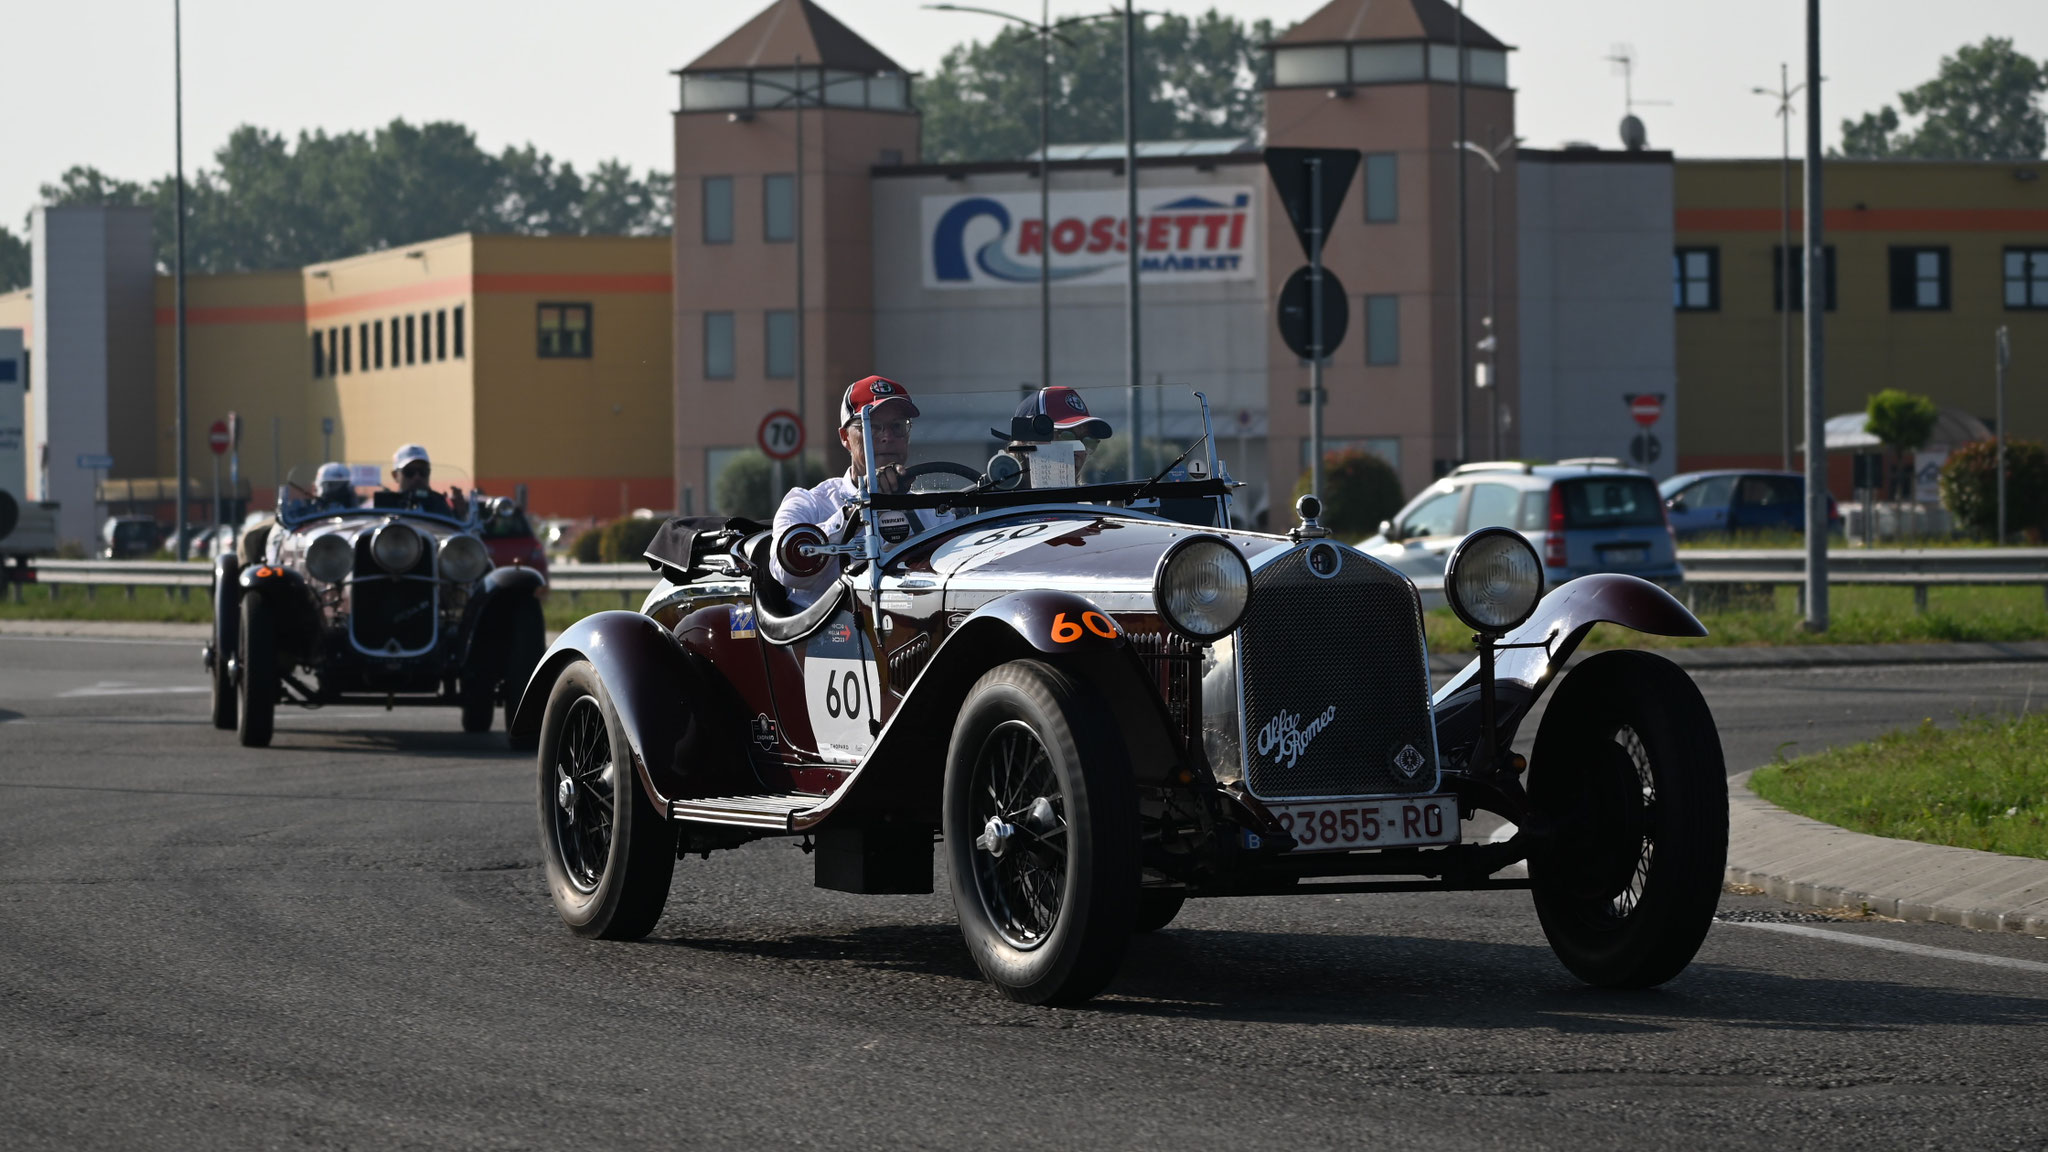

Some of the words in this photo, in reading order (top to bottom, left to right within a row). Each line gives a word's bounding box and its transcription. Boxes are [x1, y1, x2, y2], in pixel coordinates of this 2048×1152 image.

[1142, 254, 1245, 273] MARKET
[771, 423, 797, 447] 70
[973, 524, 1049, 546] 60
[256, 565, 284, 578] 61
[885, 618, 889, 628] 1
[1050, 611, 1118, 644] 60
[826, 669, 861, 720] 60
[1257, 708, 1300, 764] Alfa
[1282, 705, 1337, 769] Romeo
[1248, 834, 1261, 849] B
